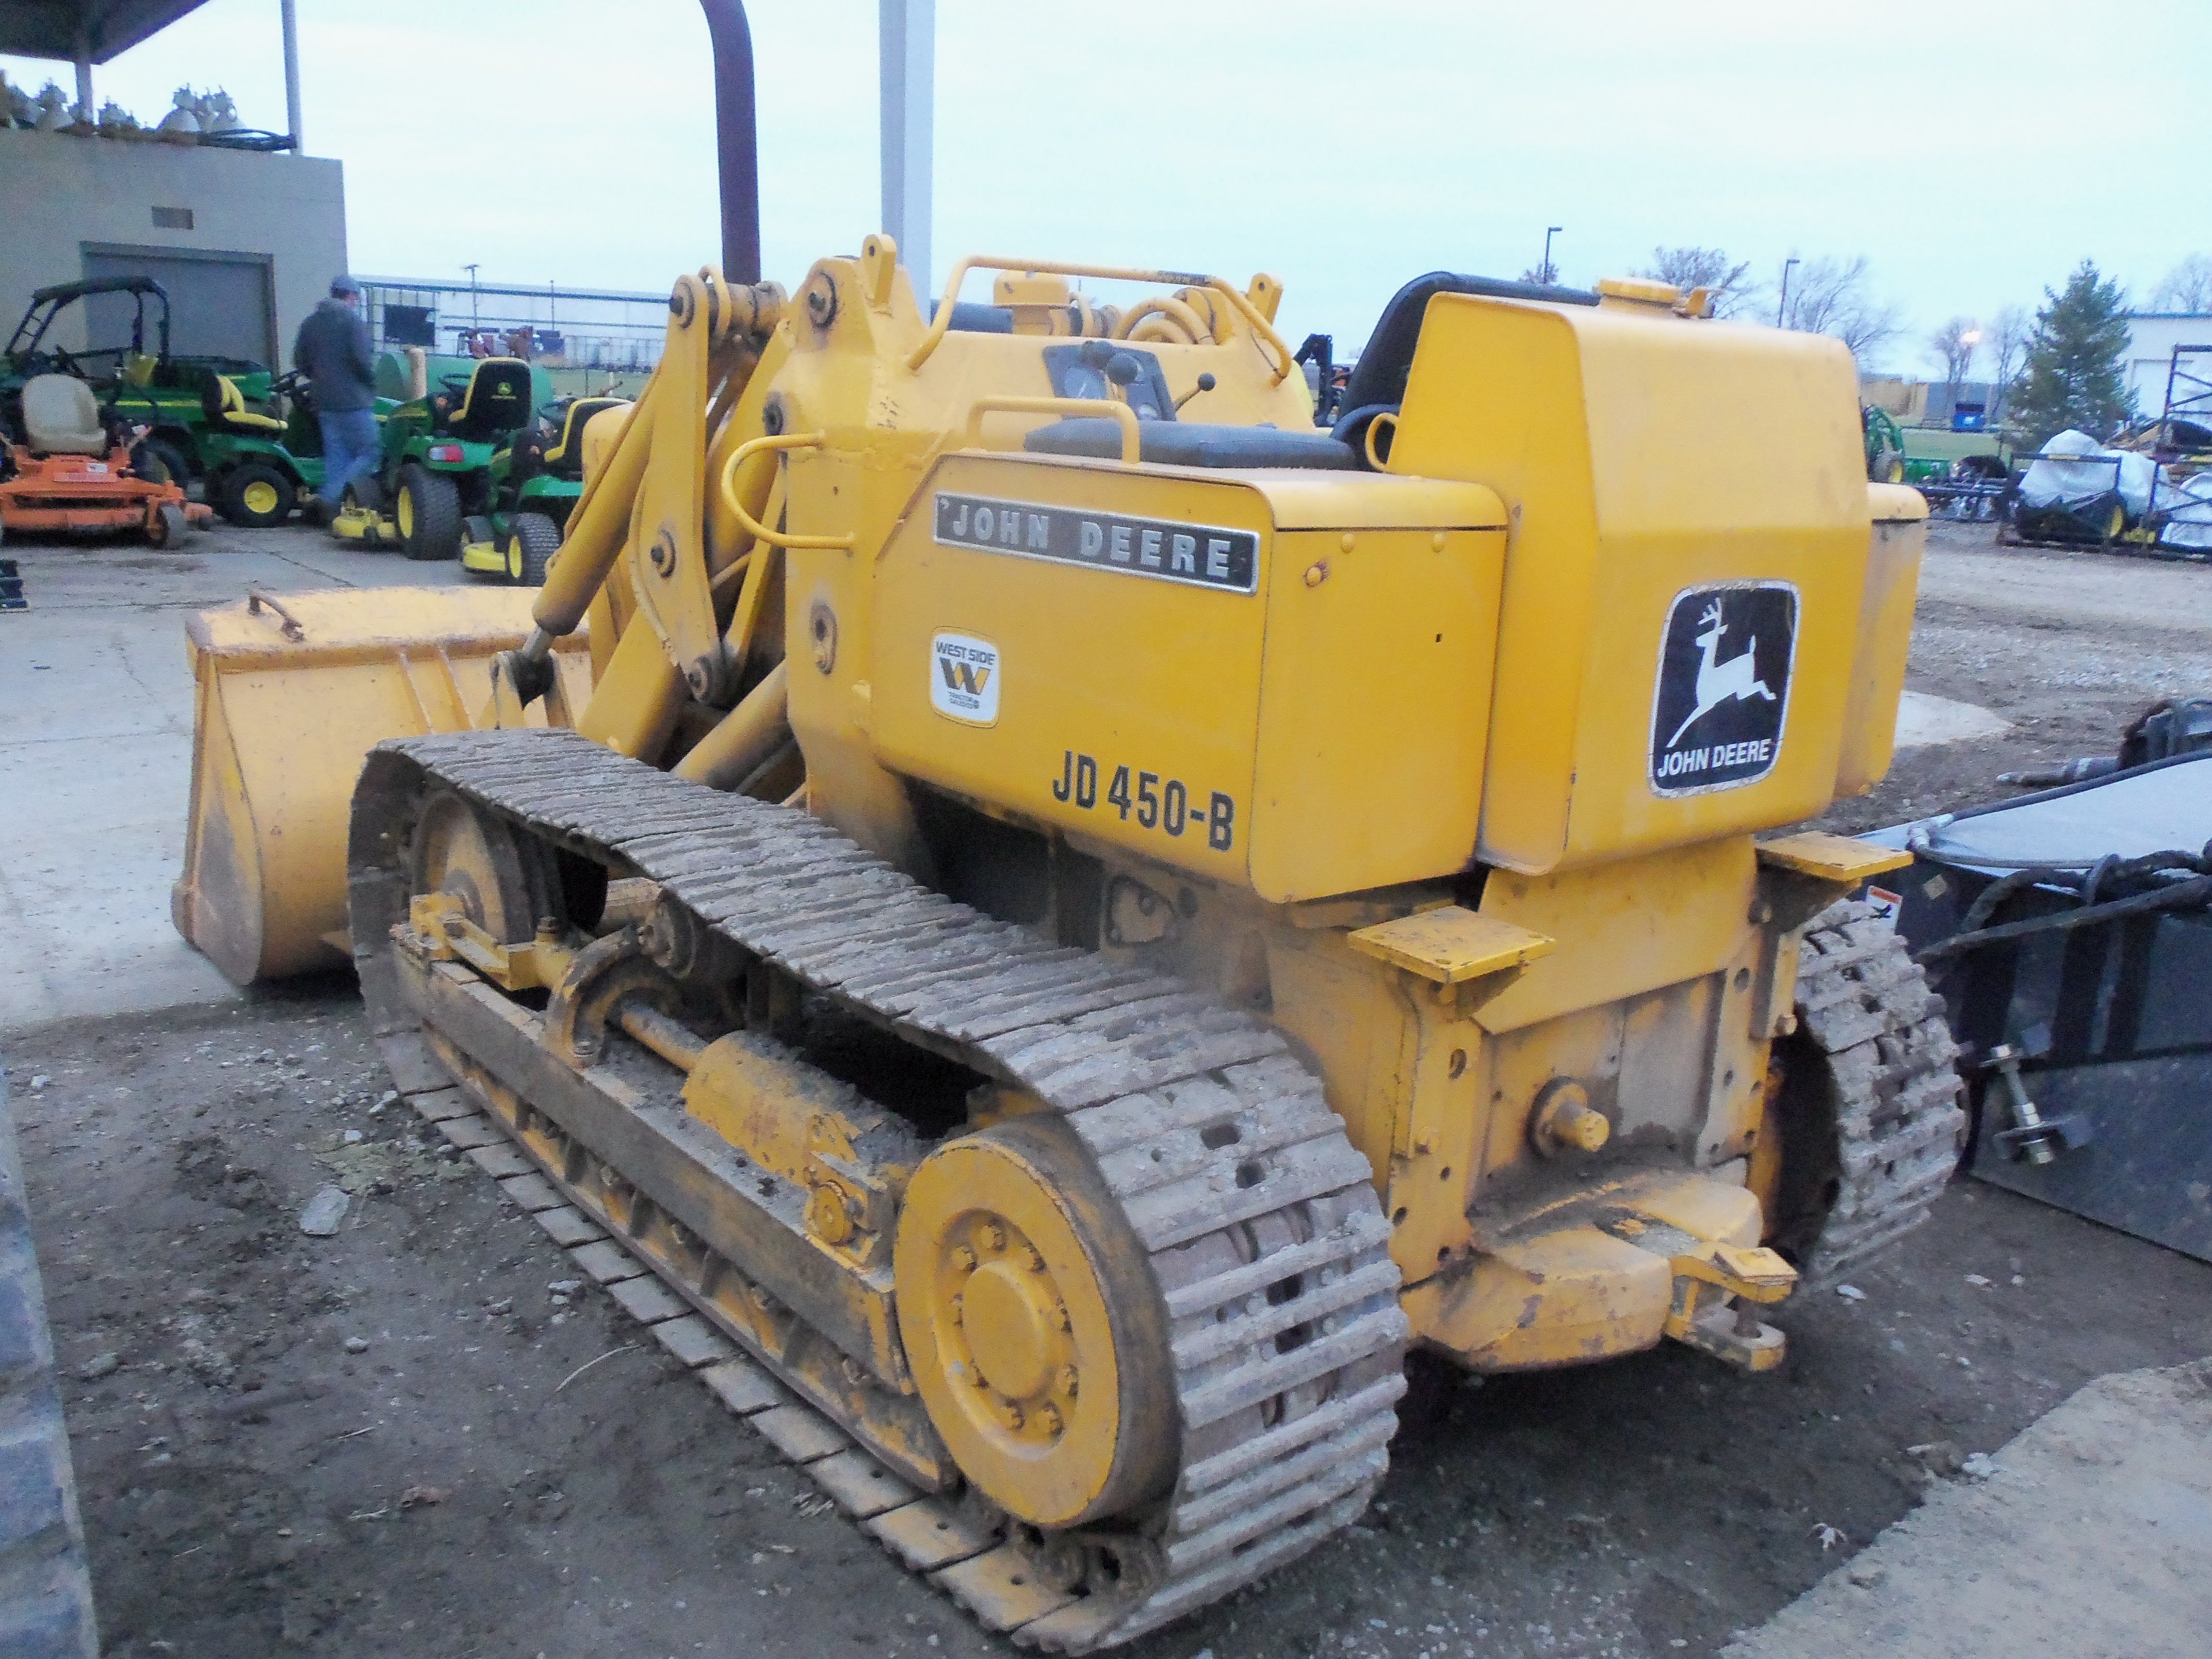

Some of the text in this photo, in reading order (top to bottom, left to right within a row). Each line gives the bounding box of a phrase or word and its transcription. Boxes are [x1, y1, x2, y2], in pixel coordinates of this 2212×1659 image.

[953, 505, 1231, 578] JOHN DEERE
[935, 641, 996, 666] WEST SIDE
[1657, 738, 1772, 778] JOHN DEERE
[1052, 750, 1235, 852] JD 450-B
